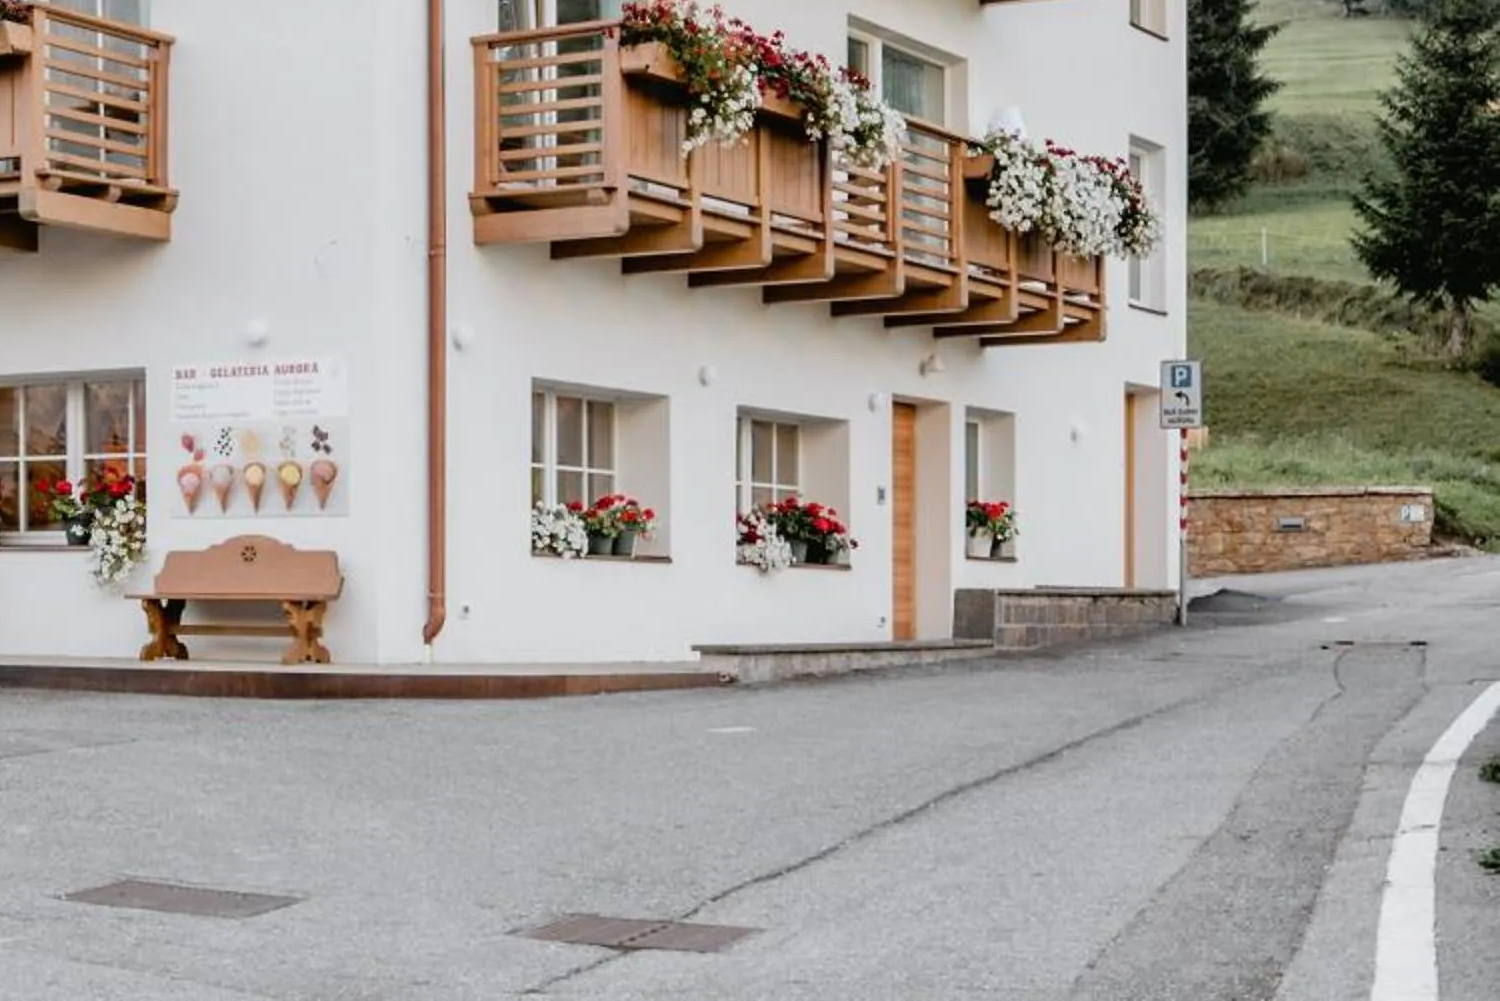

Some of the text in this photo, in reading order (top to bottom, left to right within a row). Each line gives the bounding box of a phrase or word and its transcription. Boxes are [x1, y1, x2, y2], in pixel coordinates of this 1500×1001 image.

[175, 362, 319, 380] BAR GELATERIA AURORA
[1175, 367, 1187, 386] P
